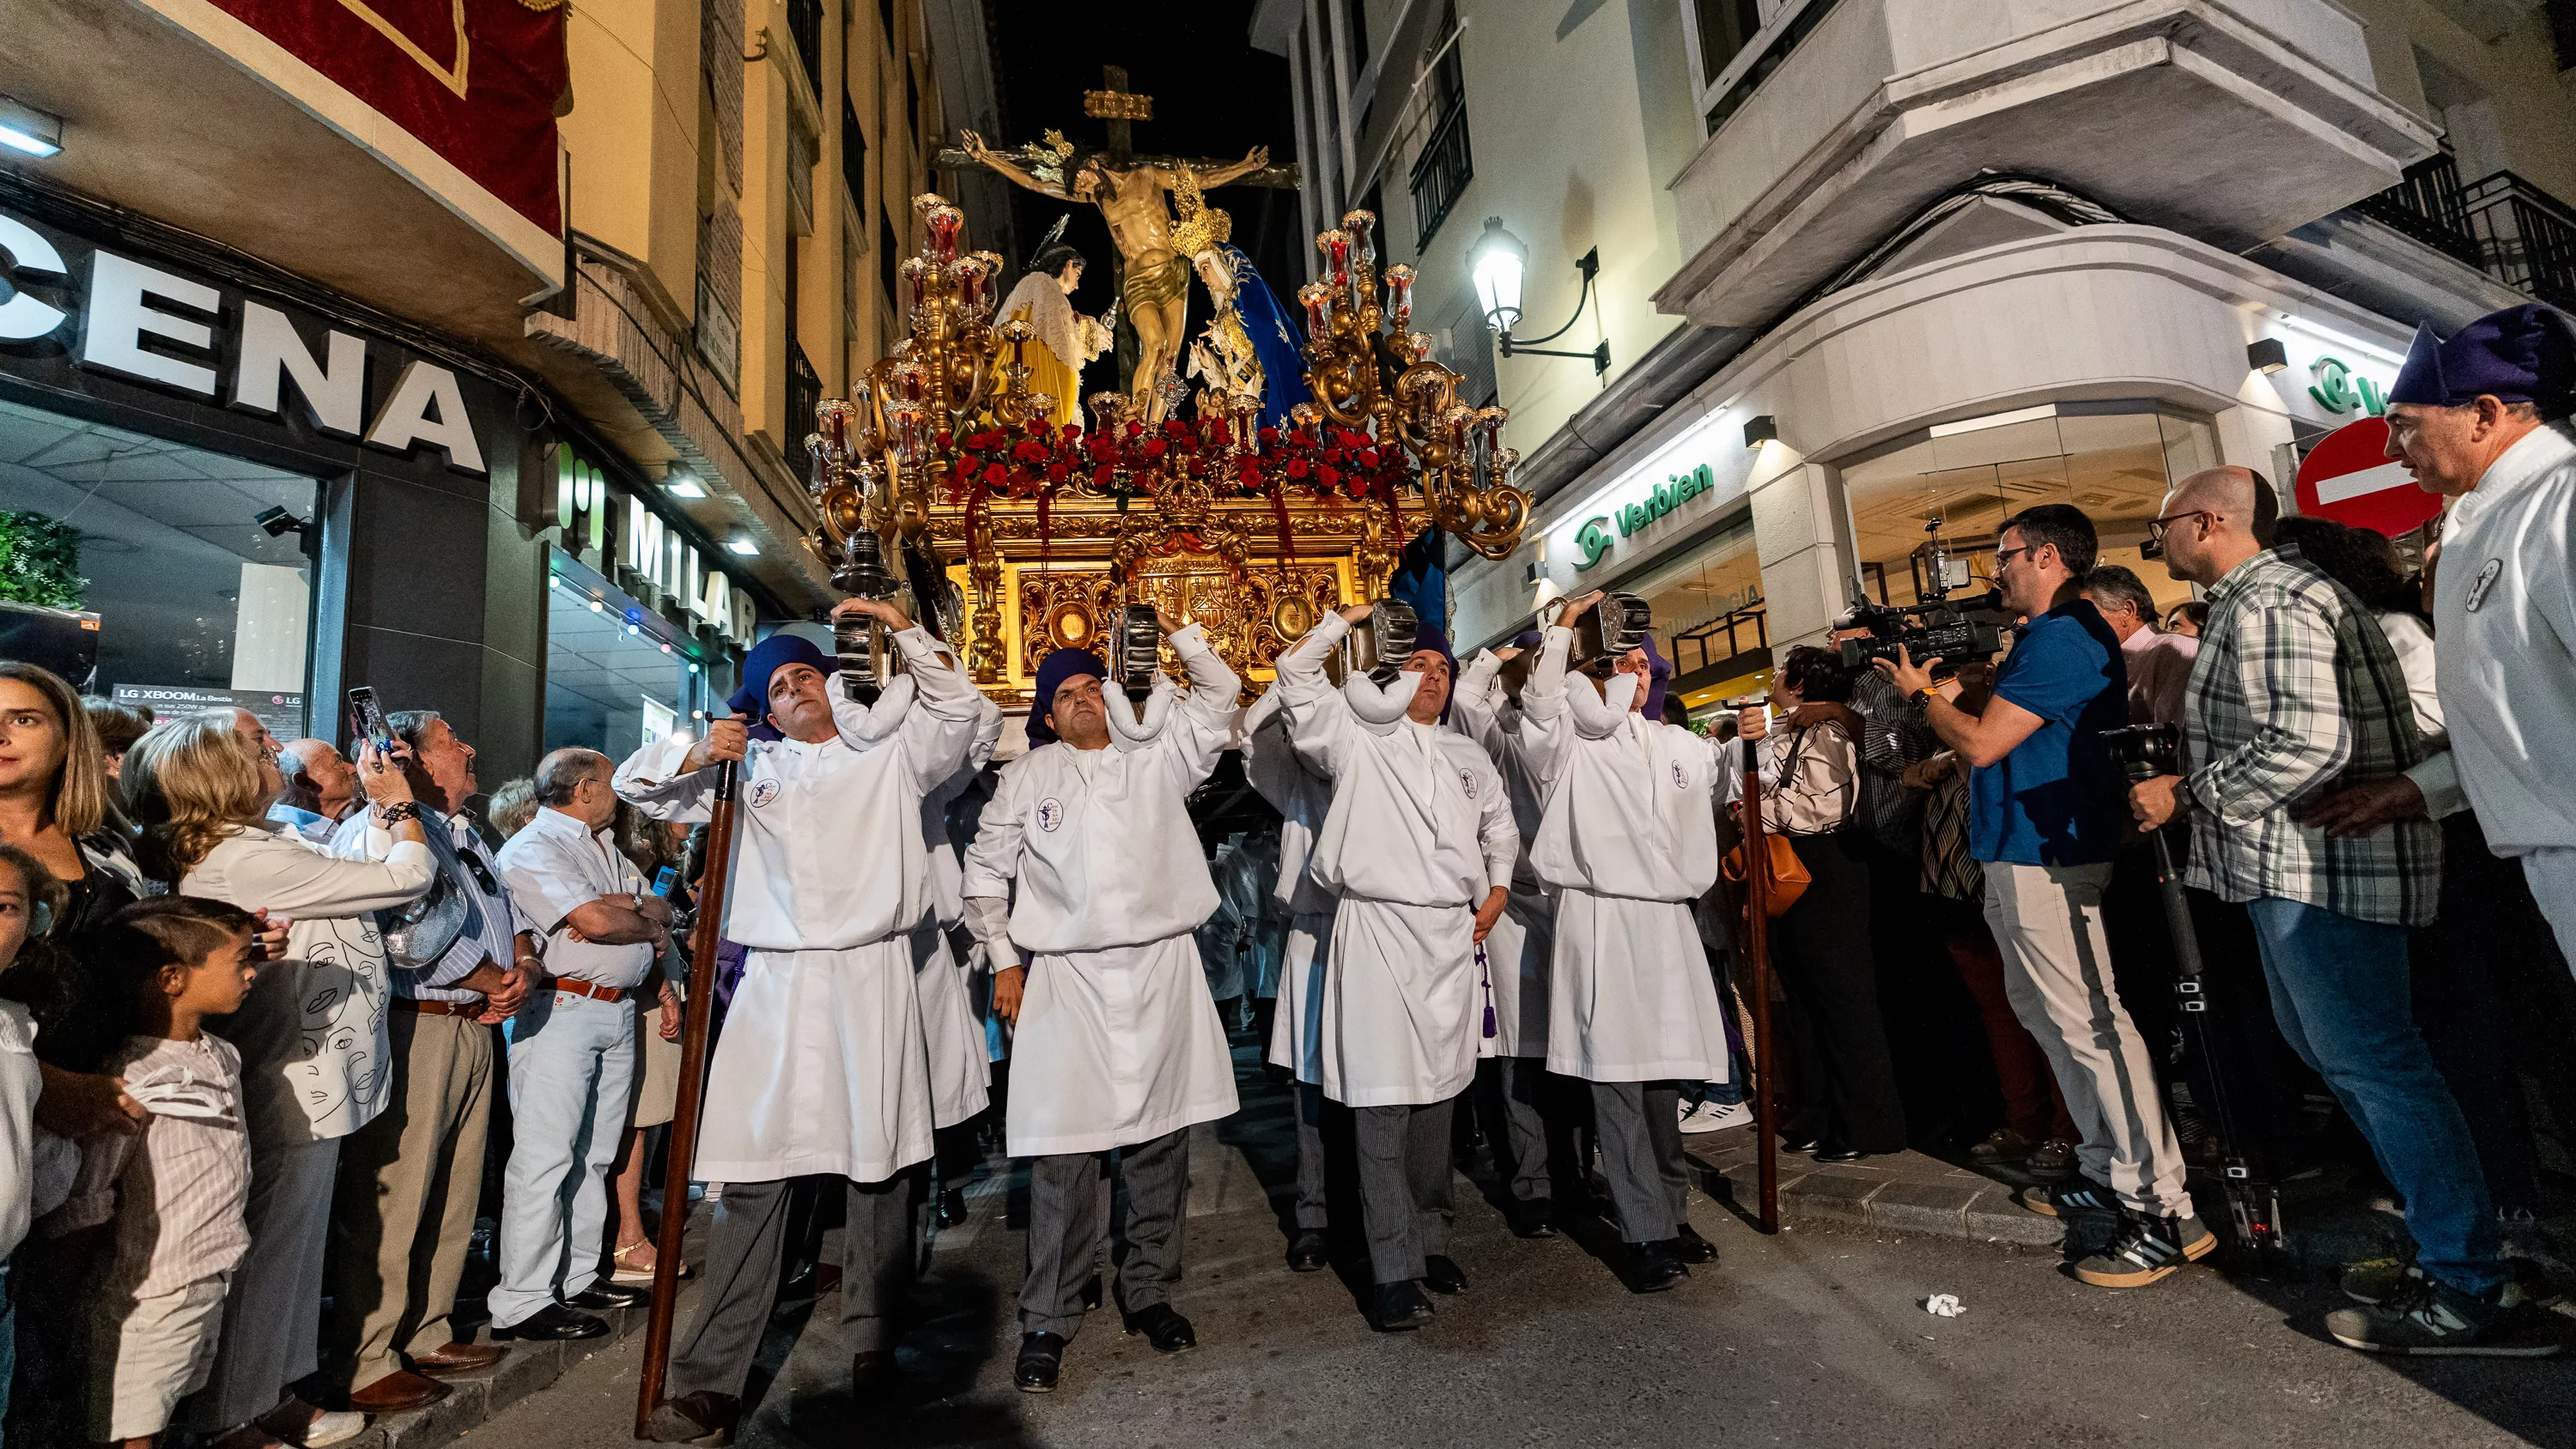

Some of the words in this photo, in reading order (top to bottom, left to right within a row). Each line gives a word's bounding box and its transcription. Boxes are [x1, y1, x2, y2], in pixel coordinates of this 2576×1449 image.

[1614, 464, 1715, 537] Verbien
[625, 494, 756, 652] MILAR
[119, 688, 139, 698] LG
[143, 690, 196, 701] XBOOM
